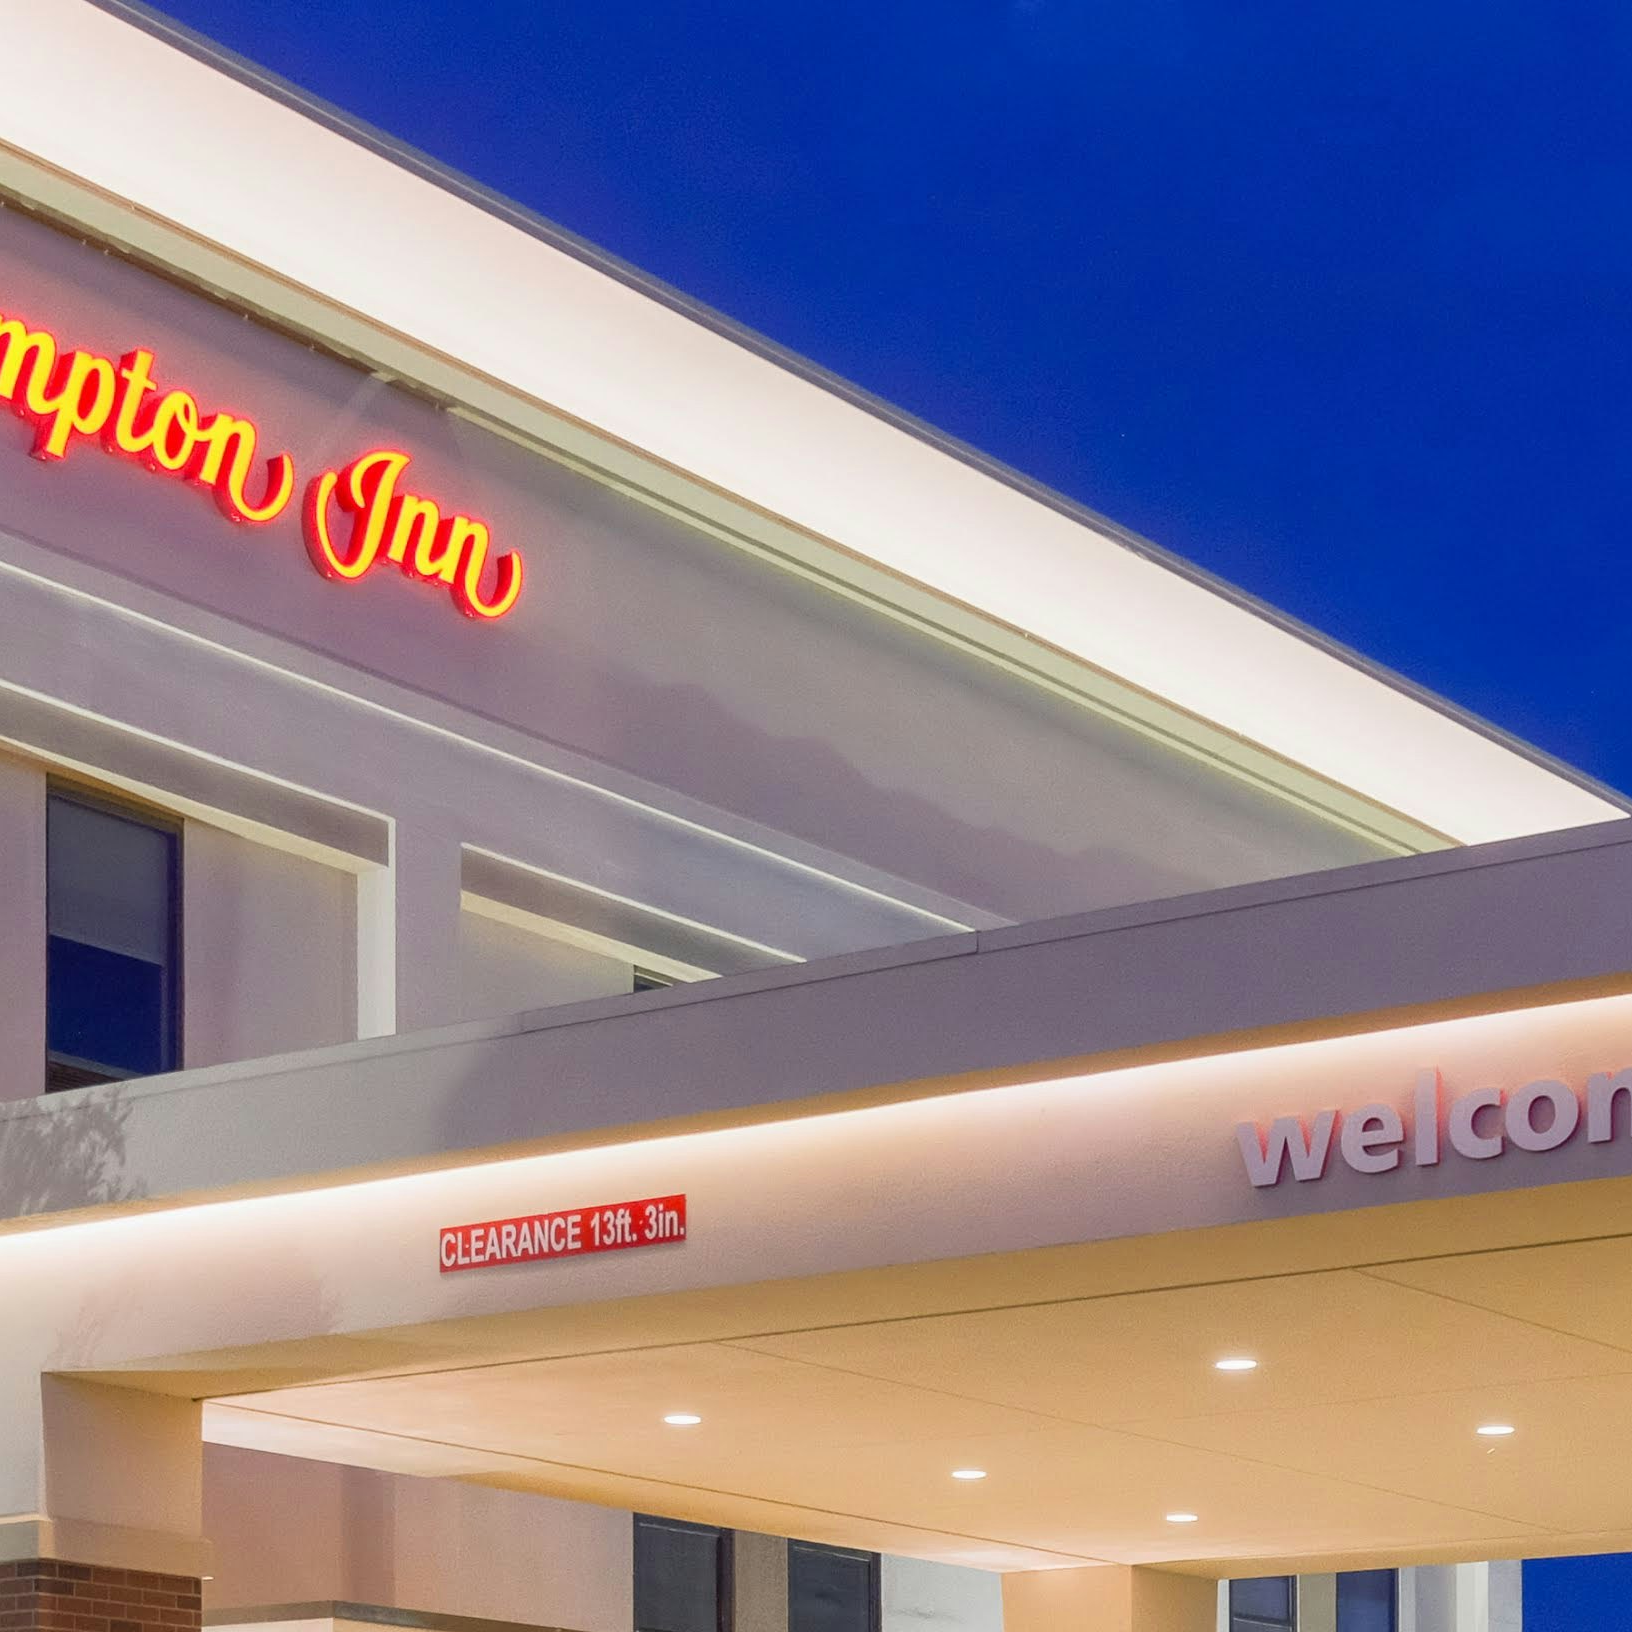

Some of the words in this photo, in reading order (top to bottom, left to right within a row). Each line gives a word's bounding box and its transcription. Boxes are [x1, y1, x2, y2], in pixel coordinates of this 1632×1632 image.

[304, 451, 523, 618] Inn
[441, 1214, 582, 1267] CLEARANCE
[590, 1208, 637, 1247] 13ft.
[644, 1203, 686, 1240] 3in.
